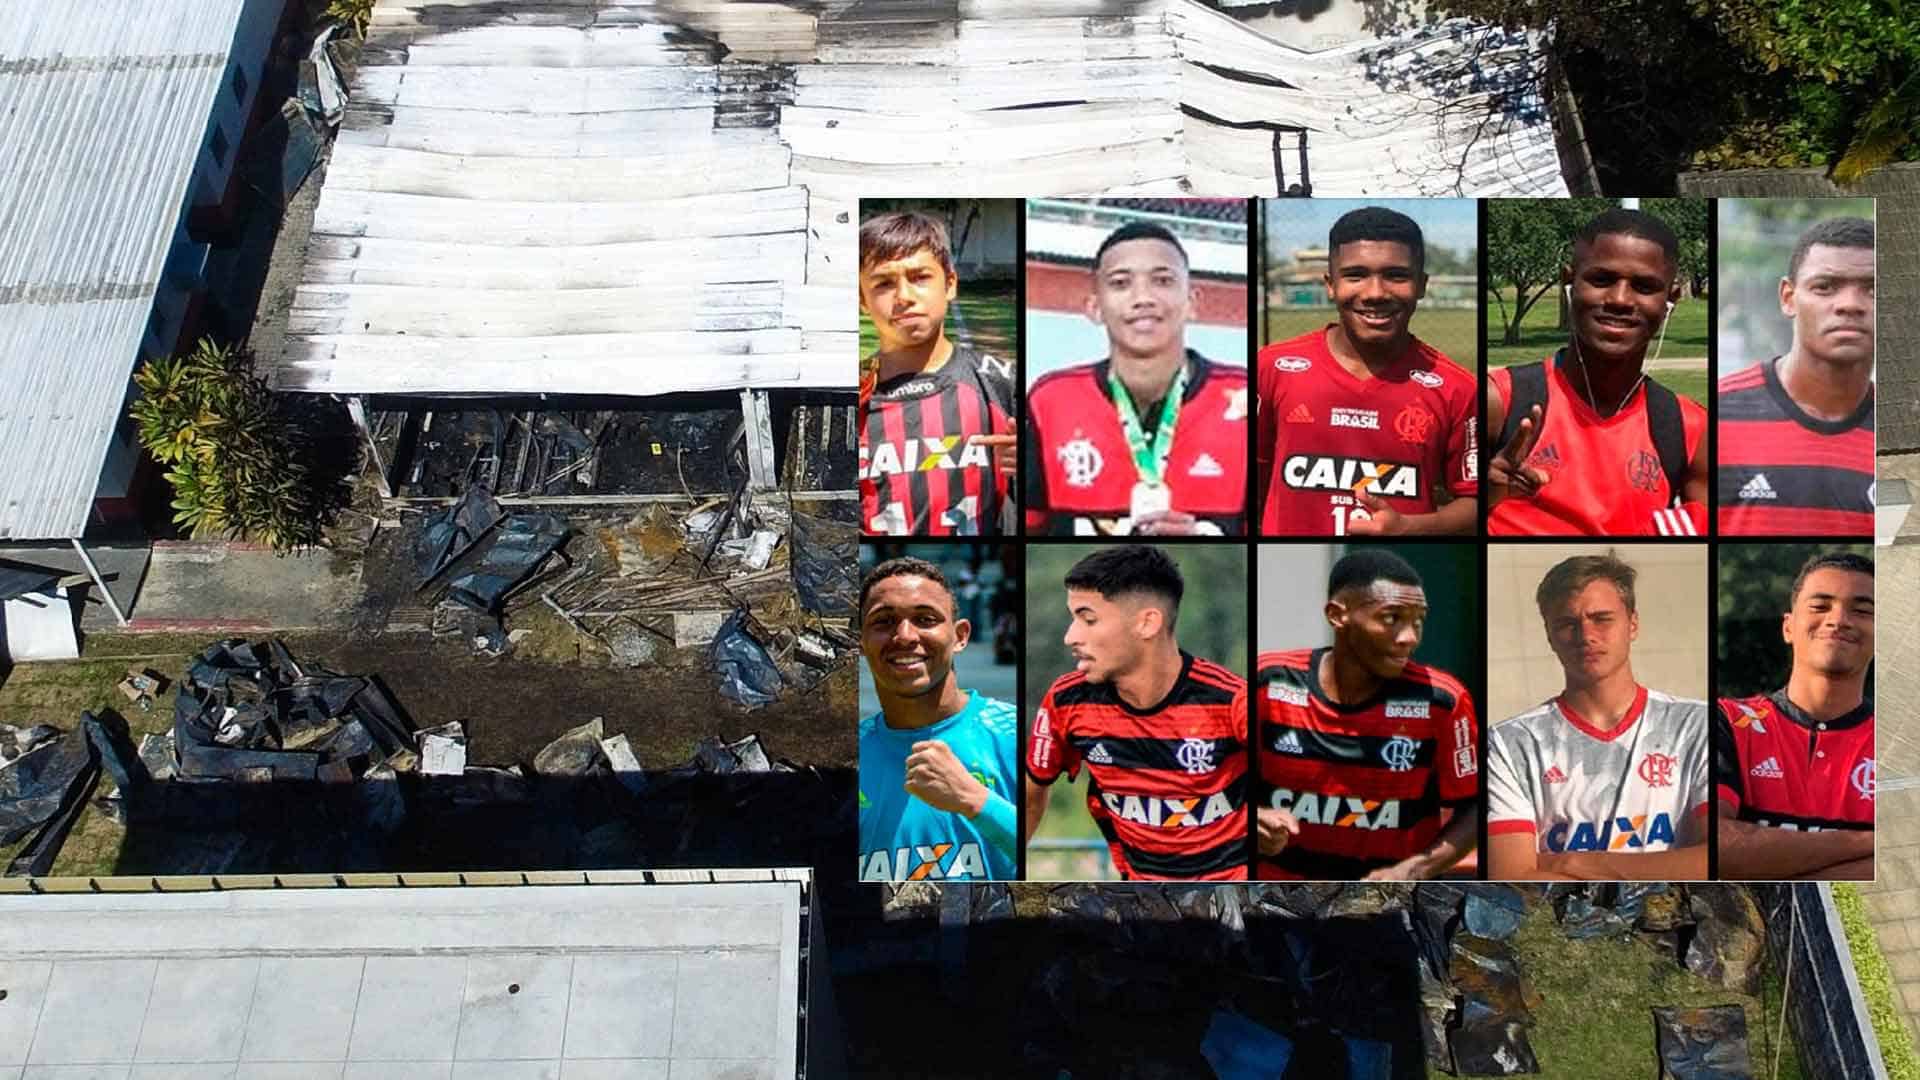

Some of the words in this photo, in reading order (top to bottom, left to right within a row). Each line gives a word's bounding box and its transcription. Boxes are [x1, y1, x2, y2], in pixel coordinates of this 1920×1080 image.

[1329, 413, 1381, 430] BRASIL
[1283, 455, 1417, 497] CAIXA
[1385, 705, 1431, 719] BRASIL
[1750, 769, 1785, 779] adidas
[1101, 791, 1234, 828] CAIXA
[1271, 788, 1401, 830] CAIXA
[1547, 812, 1676, 854] CAIXA
